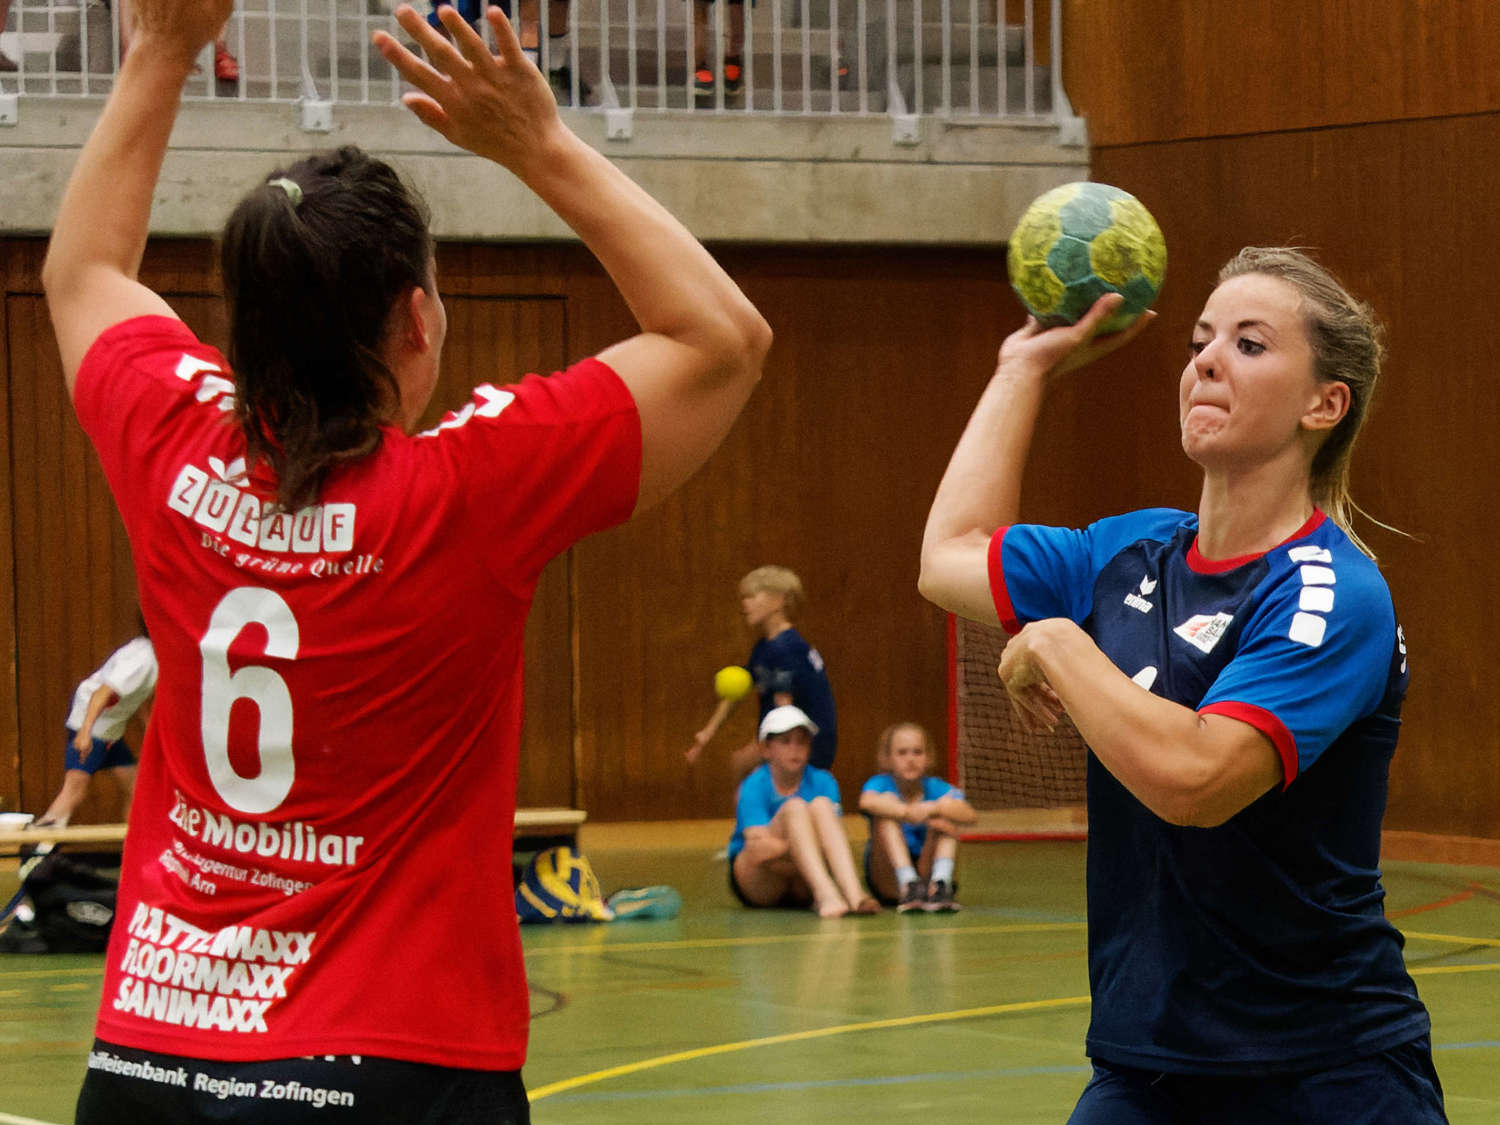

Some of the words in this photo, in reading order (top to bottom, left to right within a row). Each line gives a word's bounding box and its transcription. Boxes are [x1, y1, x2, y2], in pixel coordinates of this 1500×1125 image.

[201, 532, 230, 557] Die
[235, 553, 303, 575] grüne
[310, 555, 384, 578] Quelle
[199, 587, 300, 815] 6
[202, 808, 364, 866] Mobiliar
[121, 938, 294, 999] FLOORMAXX
[113, 977, 273, 1033] SANIMAXX
[194, 1072, 256, 1099] Region
[260, 1080, 355, 1108] Zofingen
